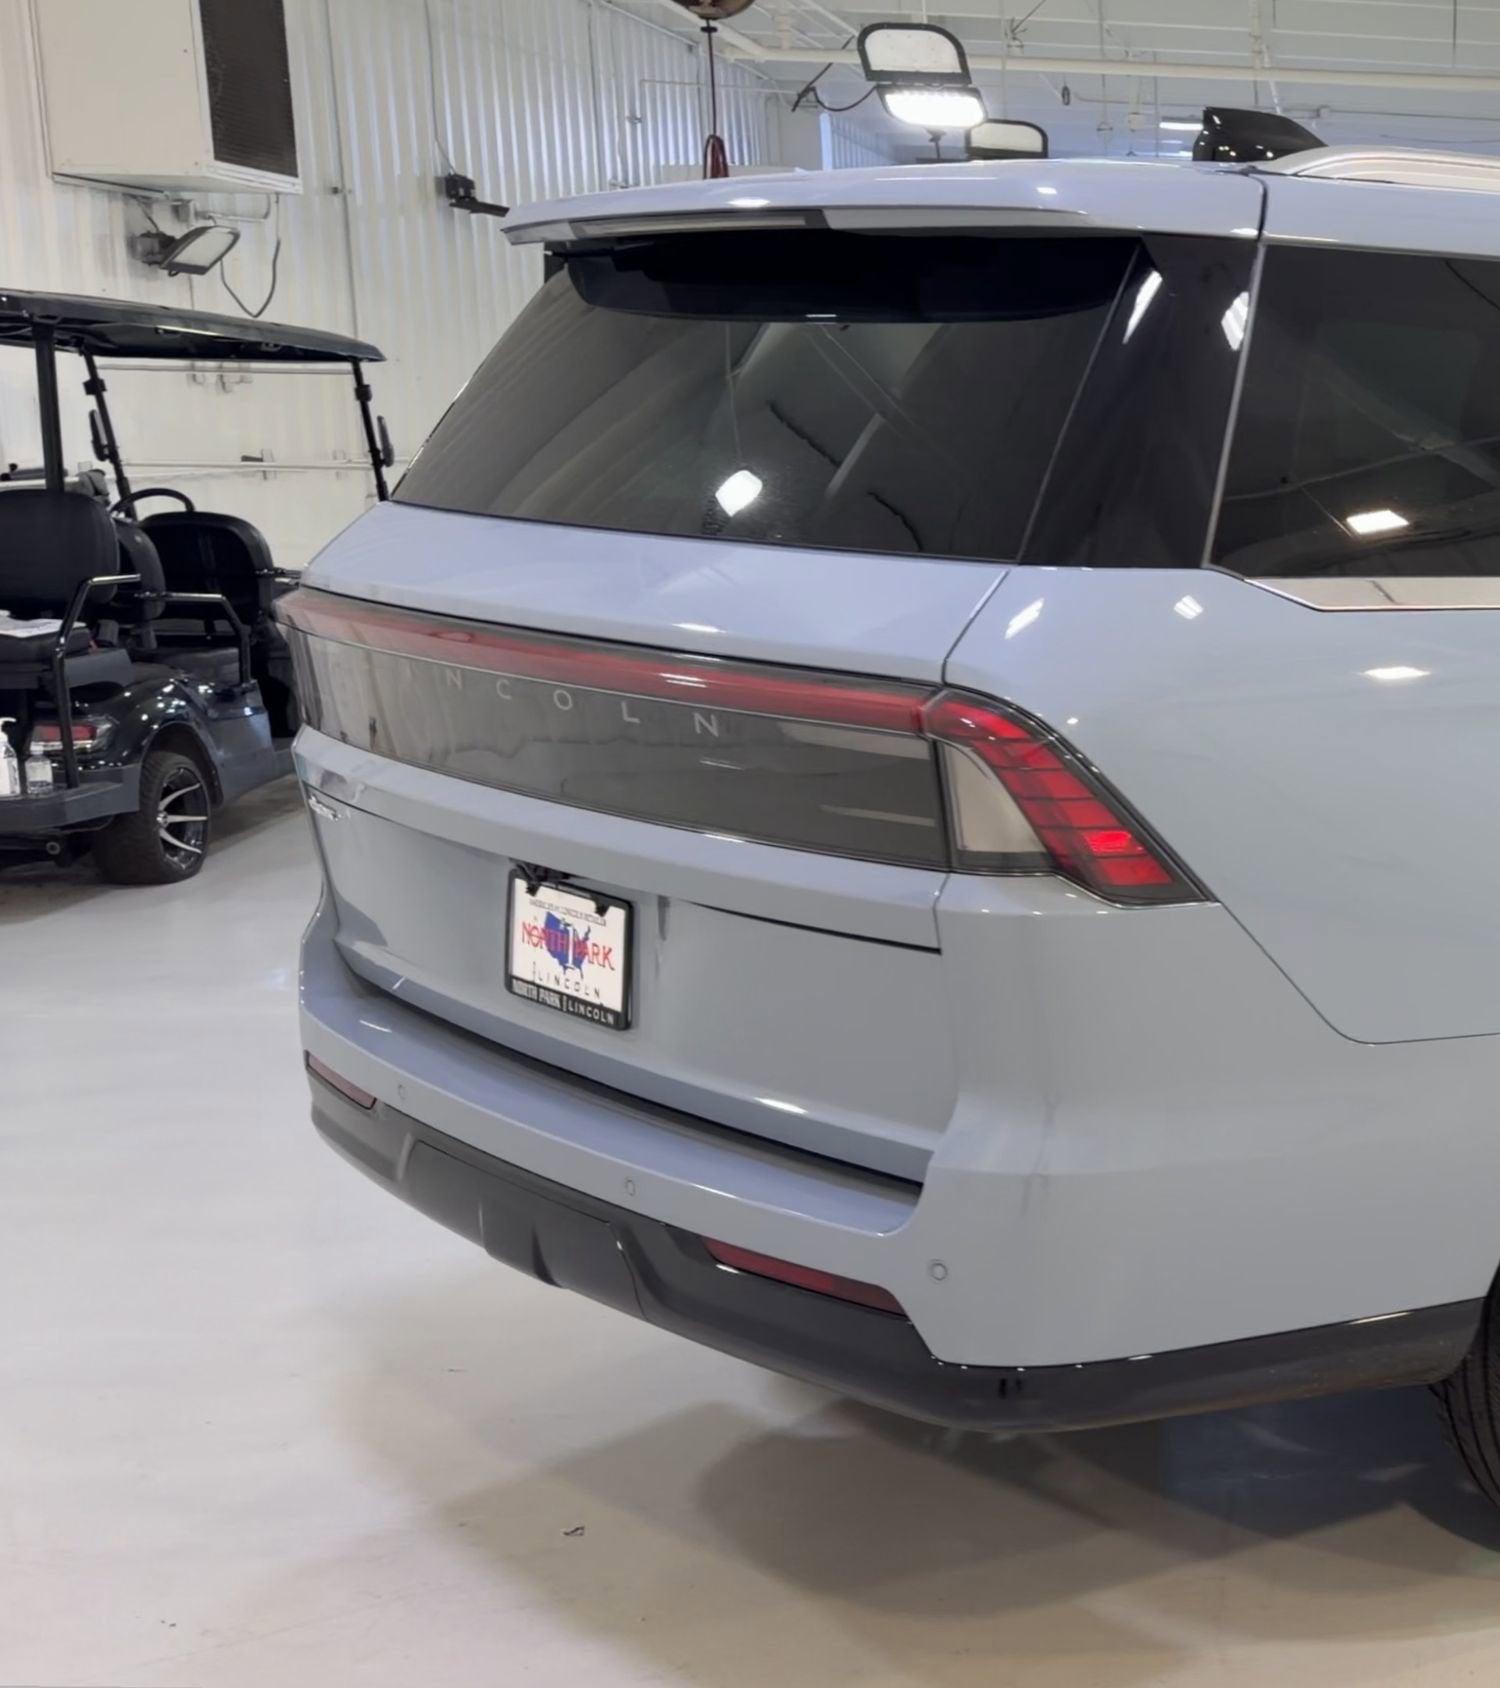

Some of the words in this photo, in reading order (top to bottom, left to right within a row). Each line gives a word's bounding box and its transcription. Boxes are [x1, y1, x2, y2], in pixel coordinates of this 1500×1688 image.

[372, 657, 720, 738] INCOLN
[538, 971, 601, 999] LINCOLN
[568, 1000, 614, 1025] LINCOLN
